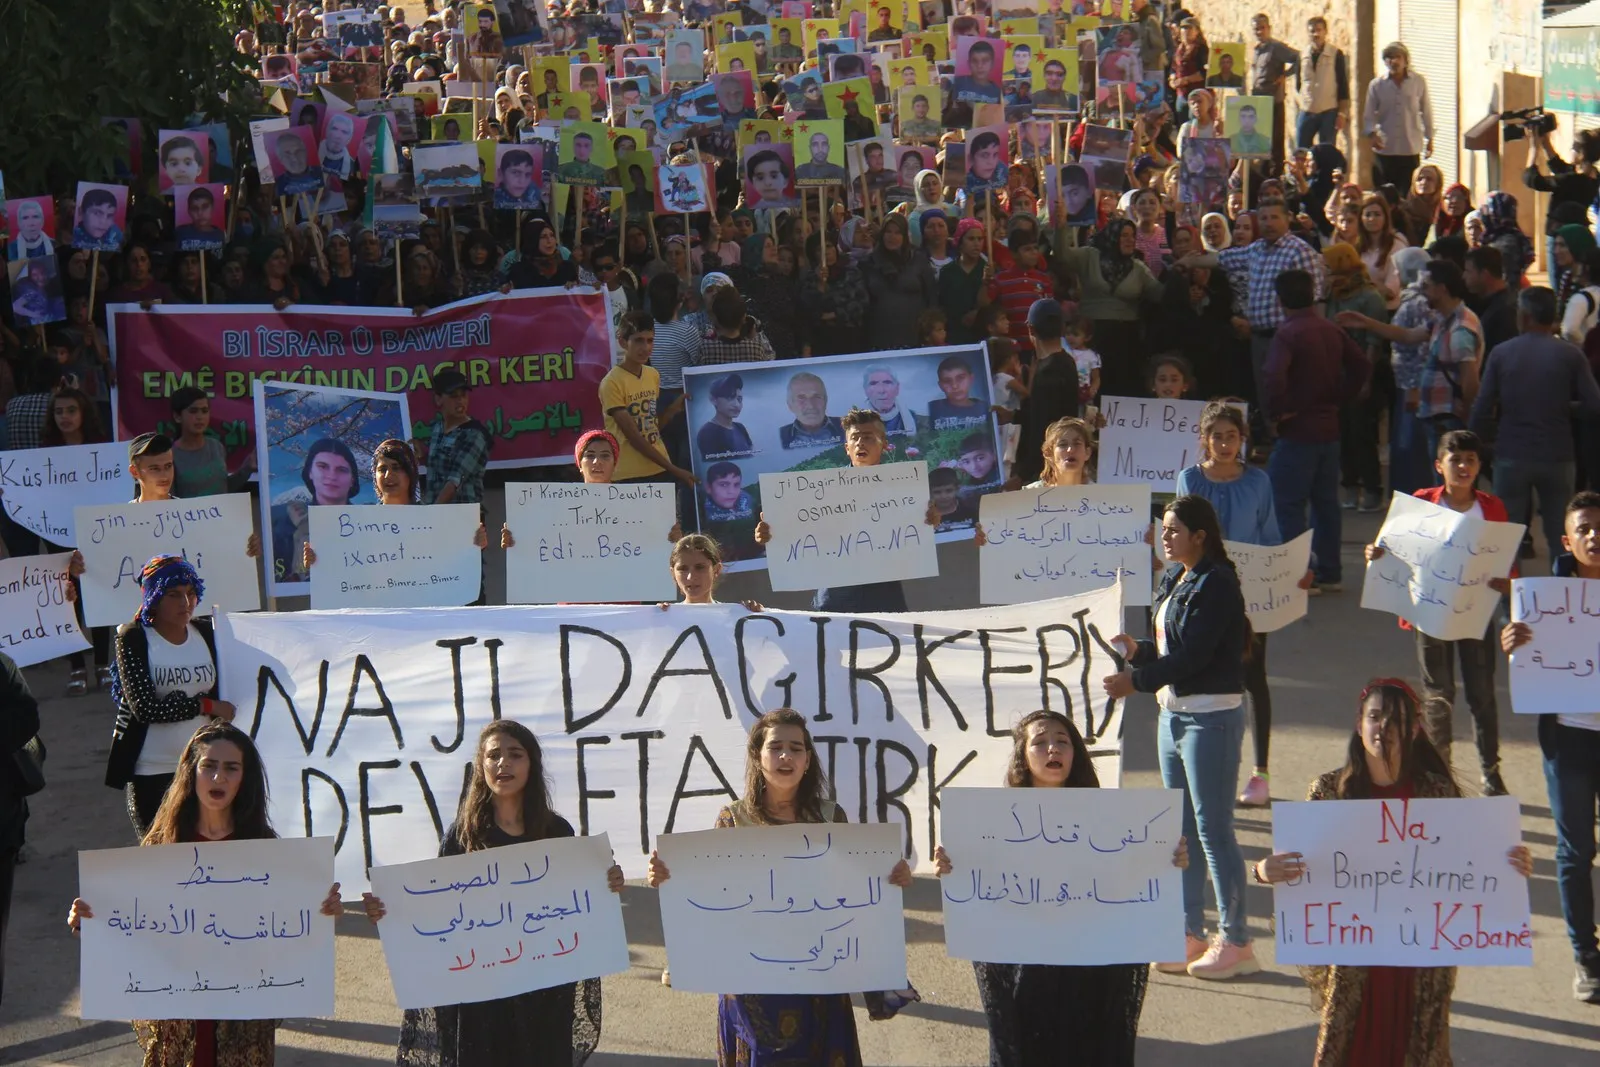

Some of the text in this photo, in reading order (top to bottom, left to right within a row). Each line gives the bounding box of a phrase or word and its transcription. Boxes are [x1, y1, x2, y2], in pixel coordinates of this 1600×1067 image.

[223, 312, 491, 357] BI ÎSRAR Û BAWERÎ
[143, 366, 215, 399] EMÊ
[501, 346, 575, 384] KERÎ
[1106, 401, 1126, 428] Na
[1132, 403, 1149, 429] Ji
[774, 478, 791, 499] Ji
[338, 513, 400, 538] Bimre
[1017, 516, 1072, 548] التركية
[0, 609, 50, 649] zad
[155, 666, 192, 686] WARD
[251, 654, 405, 757] NA
[783, 832, 831, 859] لا
[176, 846, 270, 890] يسقط
[403, 855, 550, 896] لا للصمت
[687, 869, 882, 914] للعدوان
[107, 897, 311, 945] الفاشية الأردغانية
[412, 889, 591, 943] المجتمع الدولي
[1400, 906, 1420, 946] û
[448, 948, 476, 971] لا
[749, 917, 859, 972] التركي
